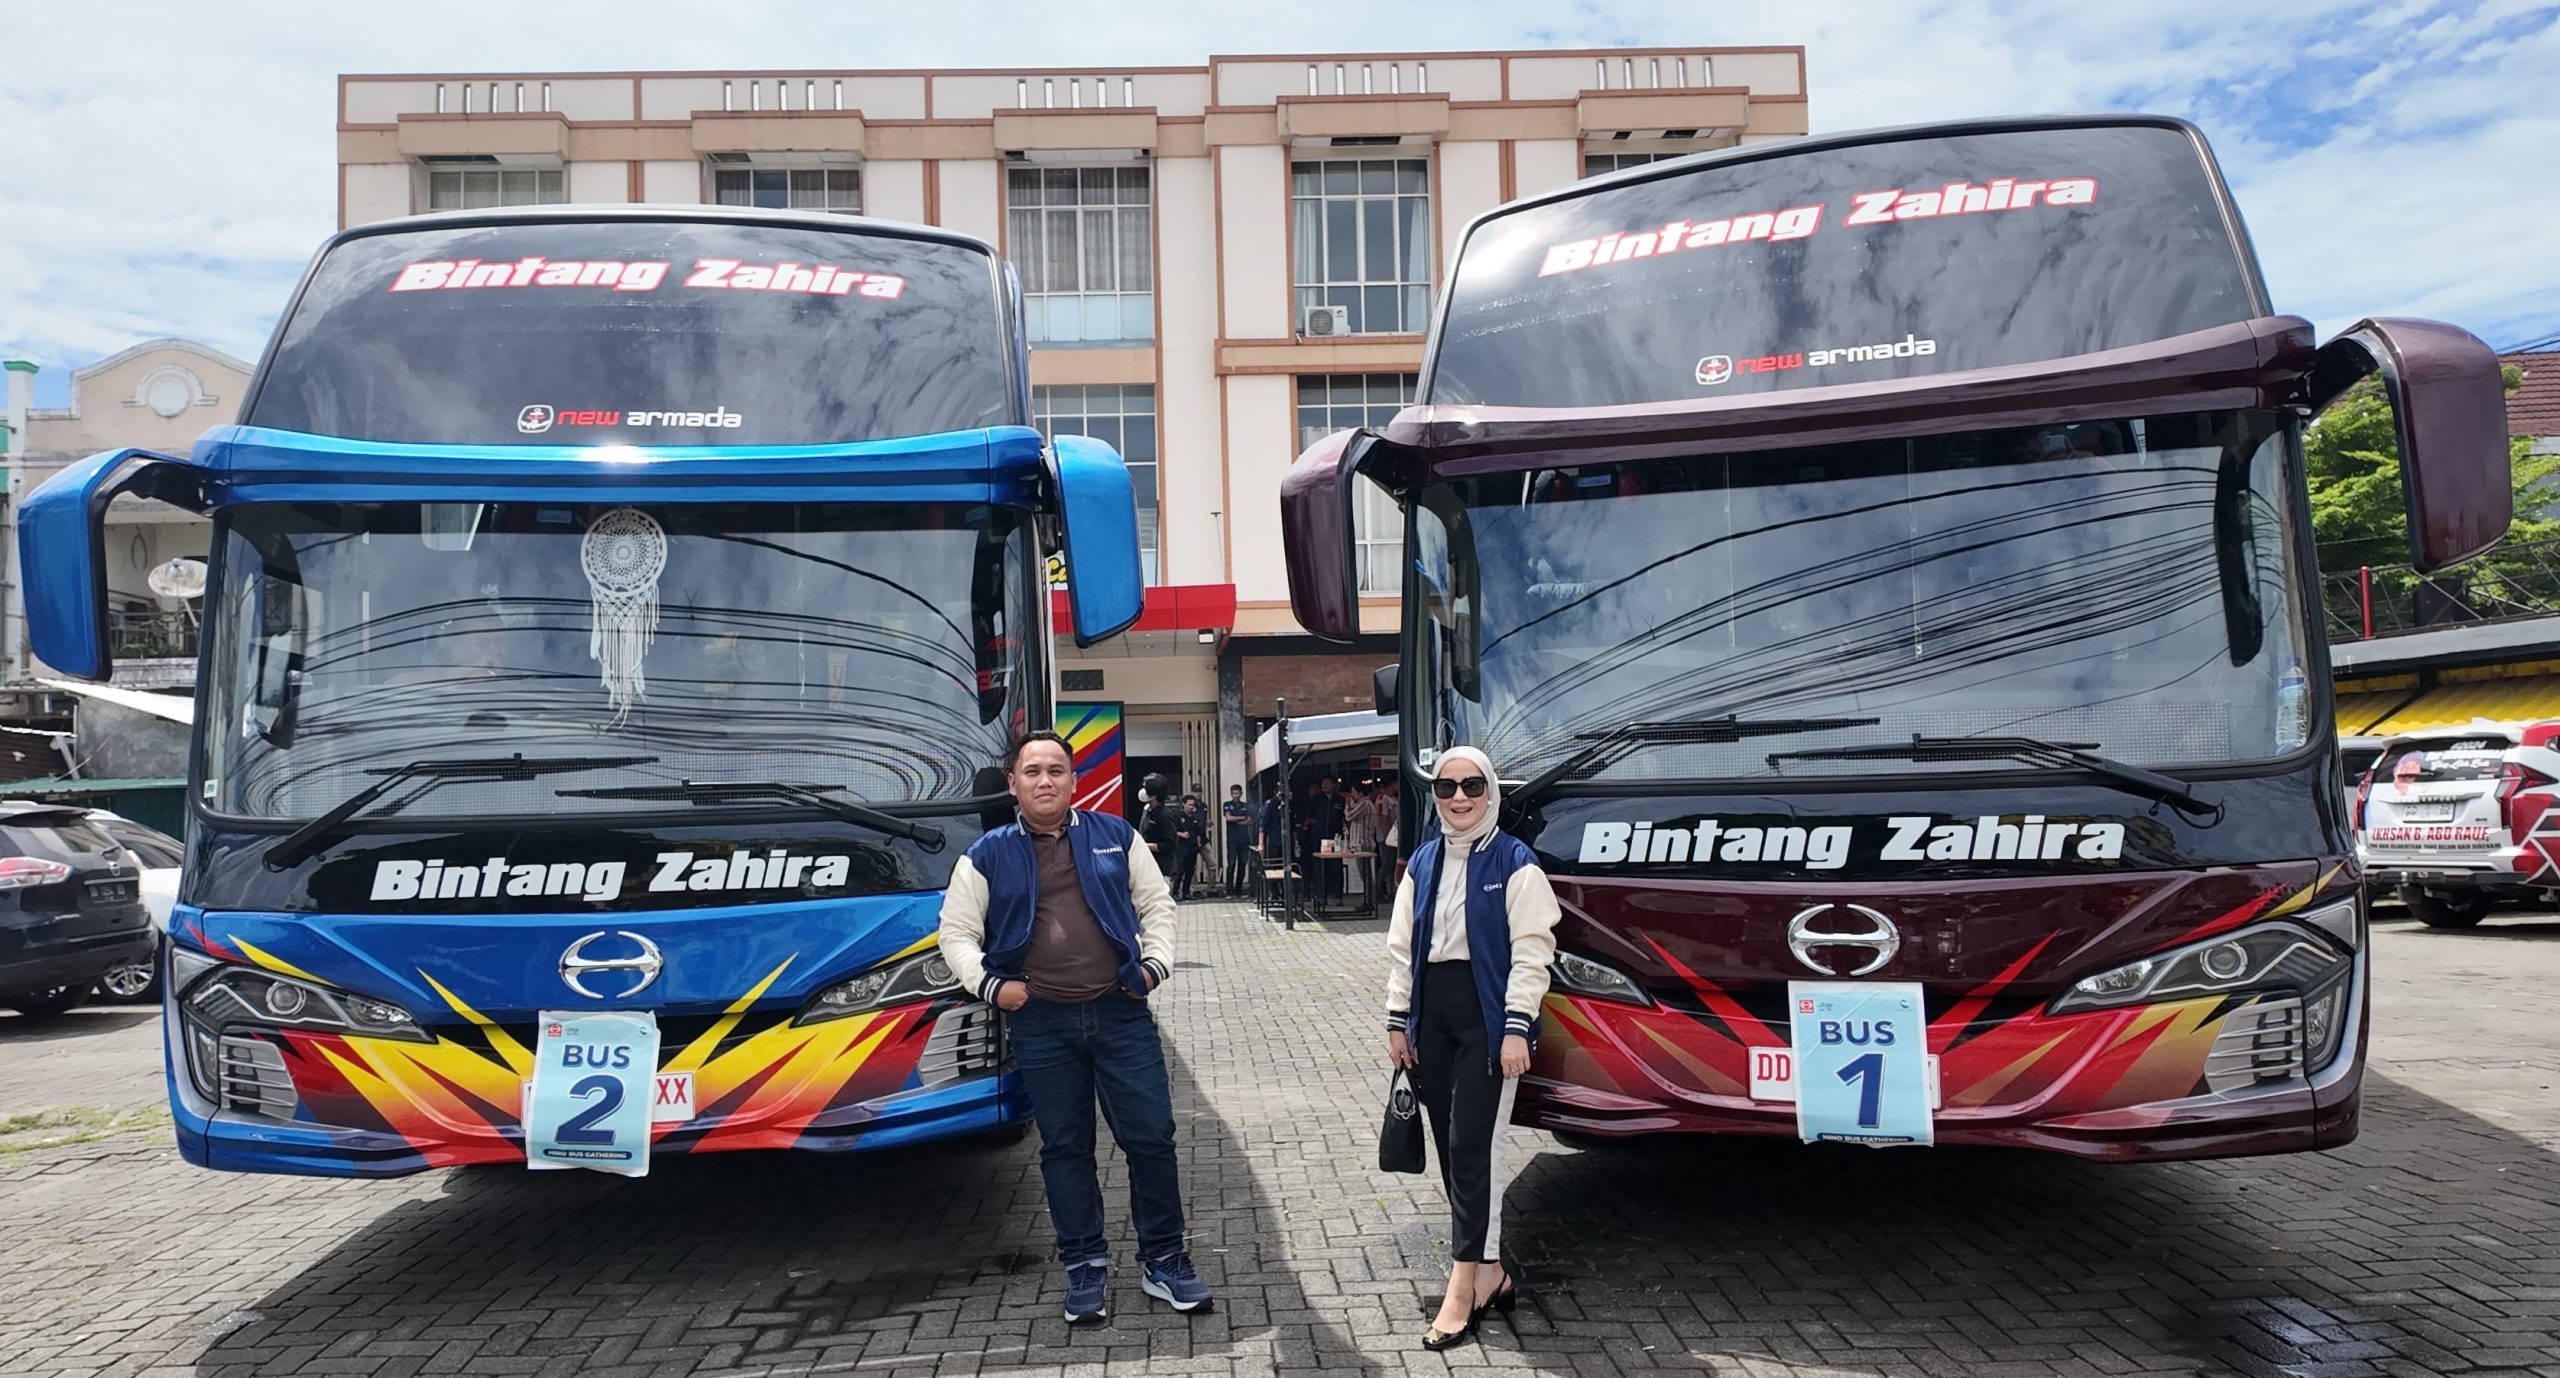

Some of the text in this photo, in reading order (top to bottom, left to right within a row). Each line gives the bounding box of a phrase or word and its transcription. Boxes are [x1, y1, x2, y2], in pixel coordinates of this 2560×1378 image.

[1537, 177, 2097, 278] Bintang Zahira
[390, 257, 904, 300] Bintang Zahira
[1735, 333, 1937, 376] new armada
[556, 405, 743, 428] new armada
[1578, 815, 2125, 869] Bintang Zahira
[2371, 827, 2412, 841] IKHSAN
[2427, 827, 2451, 840] ABD
[370, 849, 850, 902] Bintang Zahira
[1820, 1020, 1896, 1046] BUS
[562, 1044, 631, 1070] BUS
[1757, 1053, 1791, 1082] DD
[656, 1077, 688, 1105] XX
[1836, 1053, 1886, 1129] 1
[554, 1074, 626, 1146] 2
[568, 1151, 584, 1159] BUS
[585, 1152, 628, 1160] GATHERING
